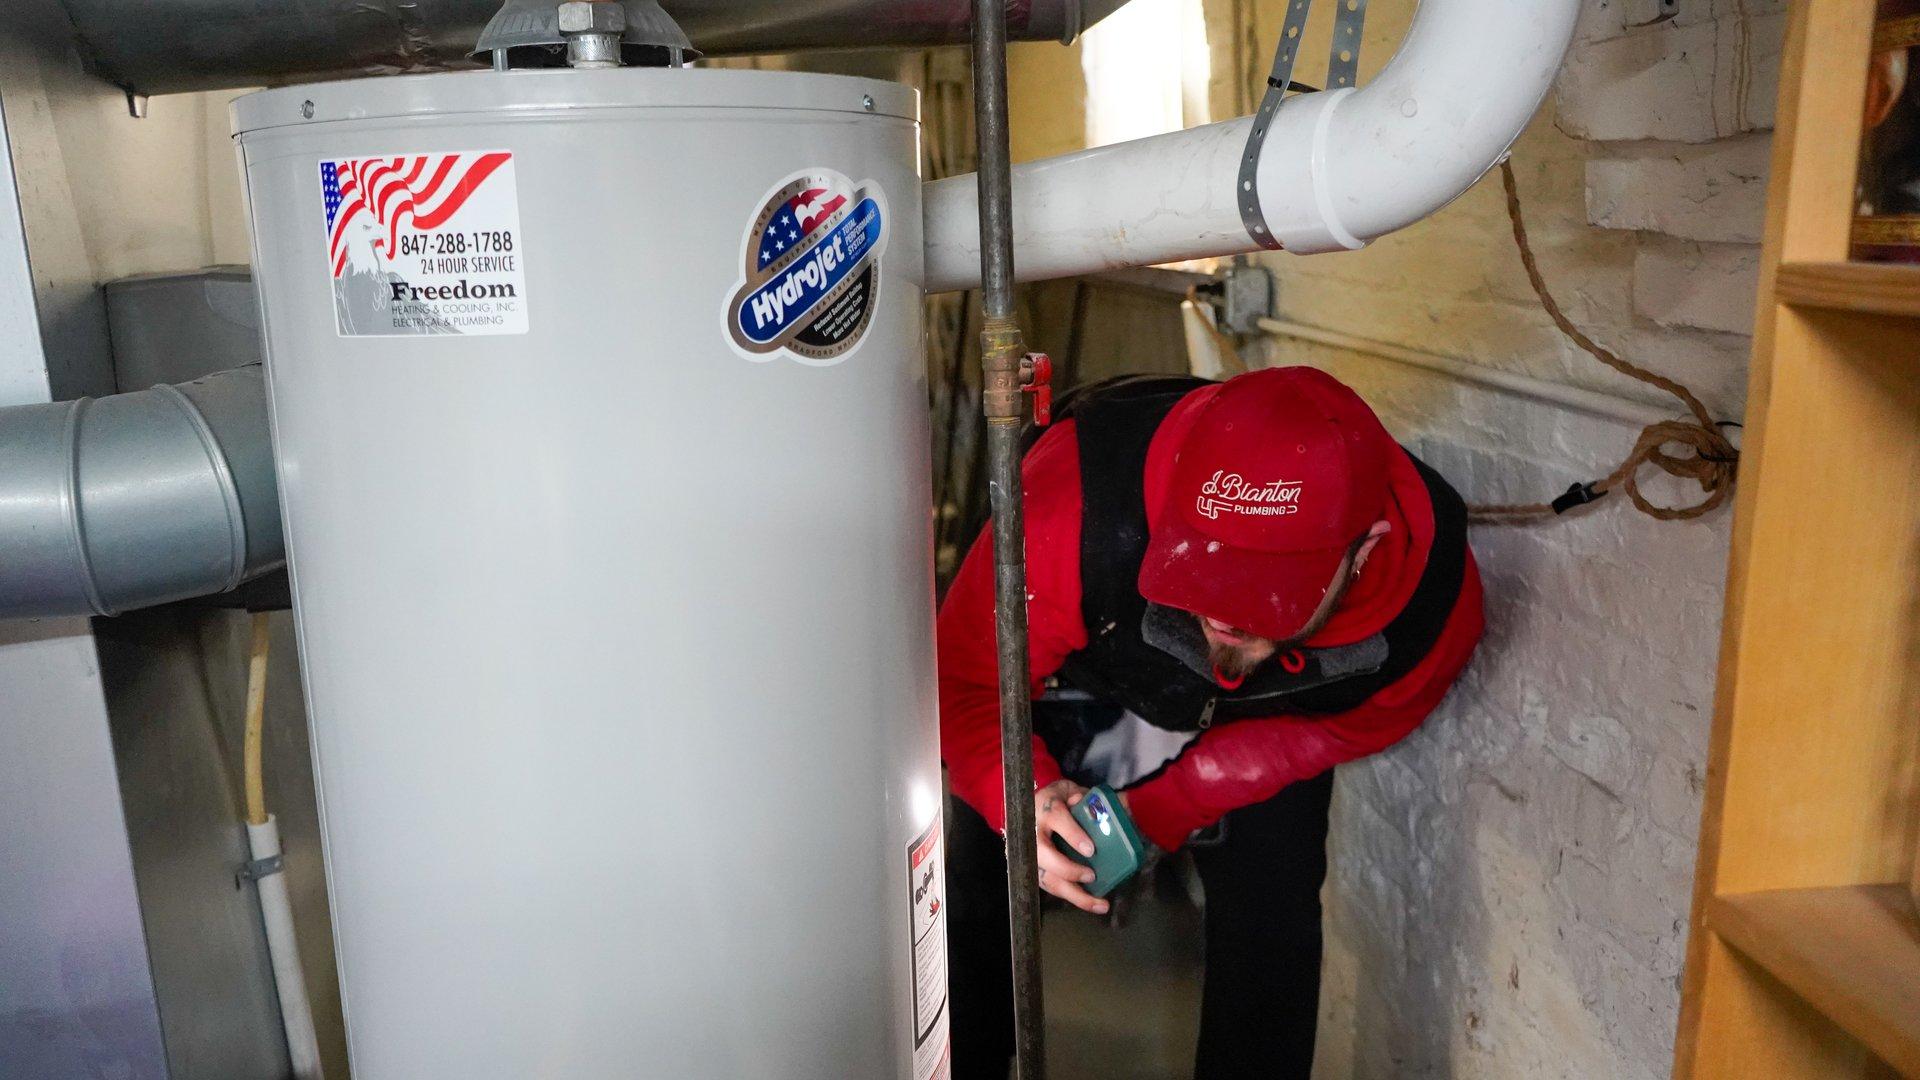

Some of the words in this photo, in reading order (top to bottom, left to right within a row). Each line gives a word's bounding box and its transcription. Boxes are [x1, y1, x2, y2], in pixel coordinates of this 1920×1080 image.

[401, 231, 513, 256] 847-288-1788
[847, 231, 866, 255] SYSTEM
[421, 258, 434, 275] 24
[438, 257, 469, 274] HOUR
[471, 255, 515, 273] SERVICE
[390, 279, 517, 301] Freedom
[751, 233, 845, 330] Hydrojet
[391, 304, 431, 315] HEATING
[433, 305, 440, 314] &
[442, 302, 494, 314] COOLING,
[393, 318, 443, 328] ELECTRICAL
[444, 317, 451, 327] &
[453, 315, 504, 326] PLUMBING
[1218, 473, 1303, 504] Blanton
[1234, 504, 1287, 516] PLUMBING
